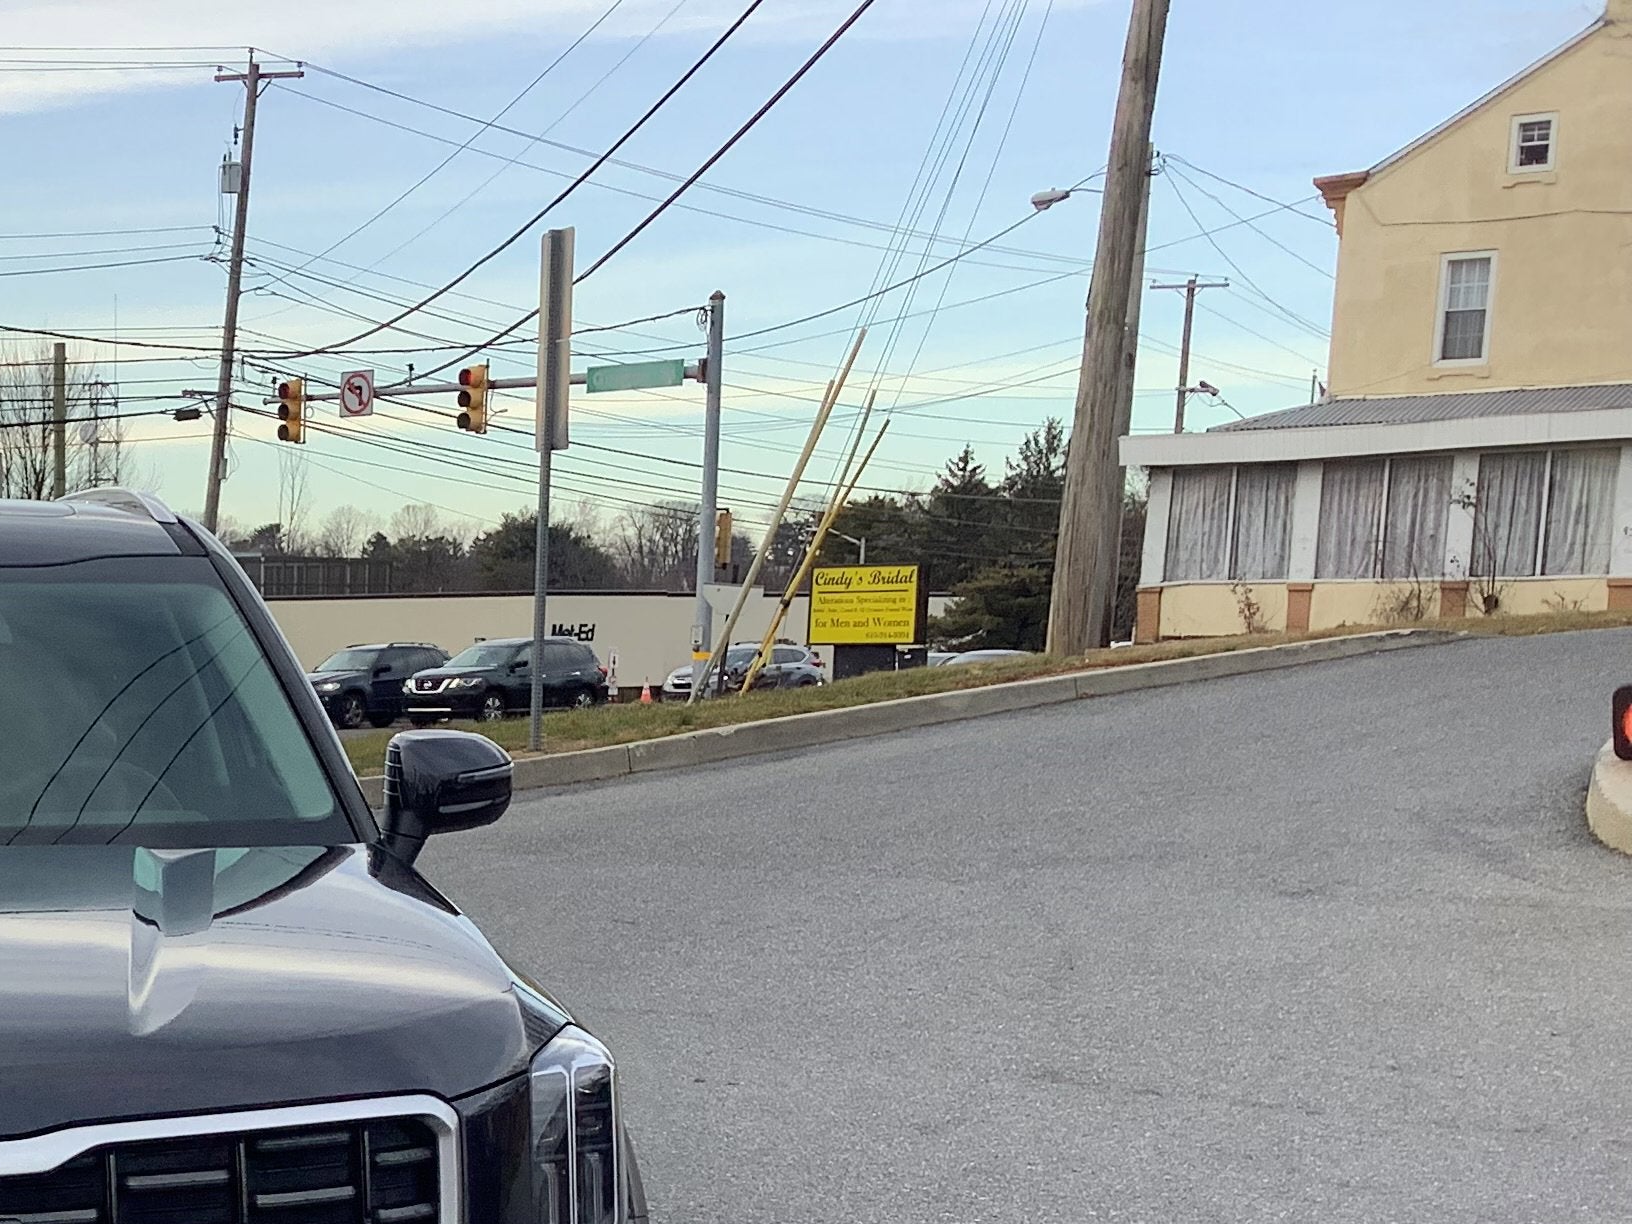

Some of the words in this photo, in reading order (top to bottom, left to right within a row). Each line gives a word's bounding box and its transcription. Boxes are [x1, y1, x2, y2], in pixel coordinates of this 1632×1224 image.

[815, 570, 863, 589] Cindy's
[868, 569, 915, 585] Bridal
[815, 618, 827, 628] for
[830, 618, 850, 628] Men
[853, 617, 869, 628] and
[873, 617, 909, 627] Women
[551, 623, 595, 641] Met-Ed
